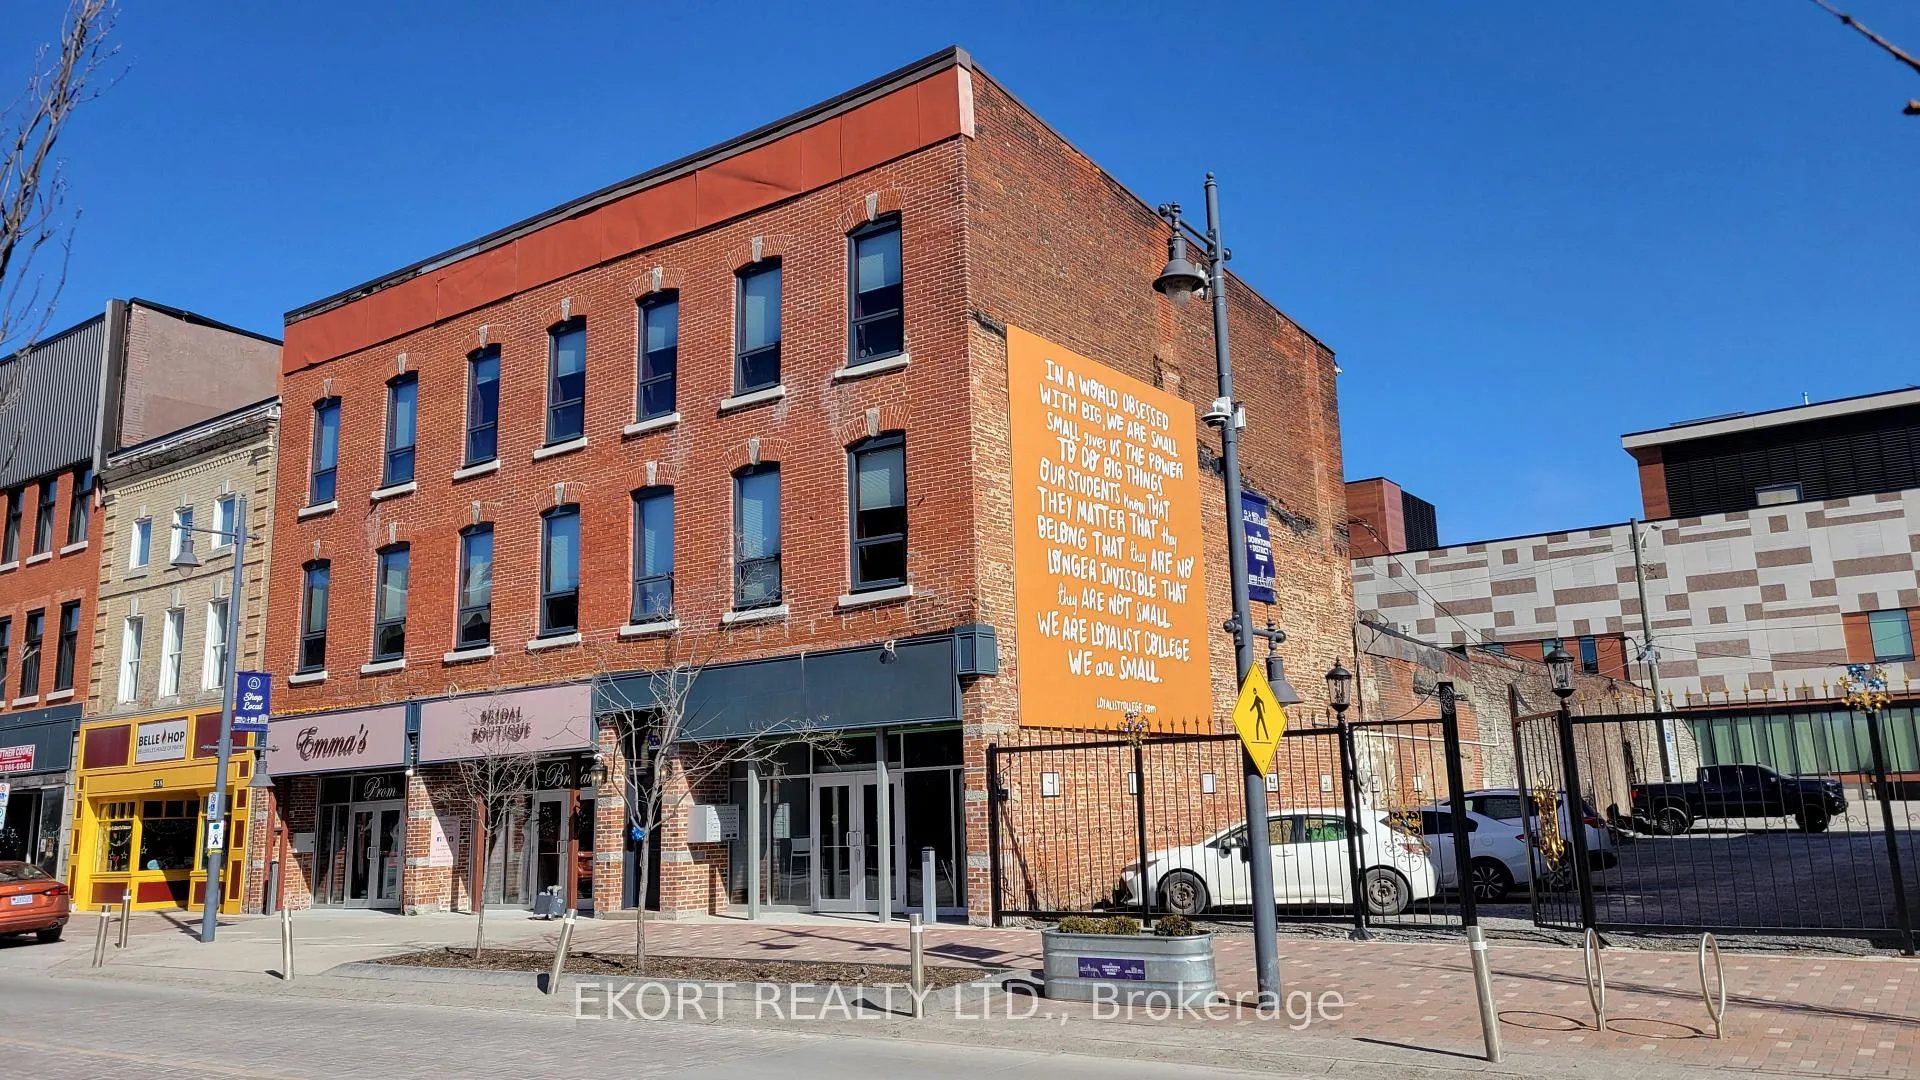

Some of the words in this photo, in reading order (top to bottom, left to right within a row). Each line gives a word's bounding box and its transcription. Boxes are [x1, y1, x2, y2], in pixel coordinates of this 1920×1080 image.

[1039, 383, 1077, 415] WITH
[1106, 413, 1124, 431] WE
[1127, 421, 1146, 443] ARE
[1045, 360, 1064, 386] IN
[1067, 371, 1076, 388] A
[1079, 375, 1118, 410] WORLD
[1123, 393, 1168, 430] OBSESSED
[1046, 411, 1080, 441] SMALL
[1084, 432, 1107, 452] gives
[1110, 439, 1120, 458] US
[1124, 443, 1144, 466] THE
[1149, 452, 1183, 480] POWER
[1056, 436, 1077, 463] TO
[1081, 446, 1100, 472] DO
[1103, 457, 1122, 480] BIG
[1040, 457, 1066, 489] OUR
[1068, 469, 1120, 504] STUDENTS
[1146, 493, 1171, 522] THAT
[1037, 486, 1072, 519] THEY
[1077, 500, 1125, 532] MATTER
[1129, 512, 1159, 540] THAT
[1161, 527, 1178, 553] they
[1037, 514, 1087, 550] BELONG
[1092, 531, 1125, 560] THAT
[1130, 540, 1147, 572] they
[1150, 549, 1173, 575] ARE
[1177, 556, 1194, 579] NO
[1048, 548, 1097, 583] LONGER
[1161, 579, 1188, 604] THAT
[1057, 582, 1078, 616] they
[1081, 588, 1104, 613] ARE
[1108, 596, 1132, 620] NOT
[1136, 601, 1173, 629] SMALL.
[1037, 611, 1059, 638] WE
[1062, 616, 1087, 644] ARE
[1091, 621, 1141, 654] LOYALIST
[1068, 649, 1093, 676] WE
[1095, 660, 1115, 677] are
[1119, 656, 1163, 684] SMALL.
[243, 691, 263, 703] Shop
[243, 701, 263, 711] Local
[138, 733, 160, 747] BELLE
[167, 730, 185, 744] HOP
[296, 723, 369, 761] Emma's
[364, 776, 397, 800] Prom
